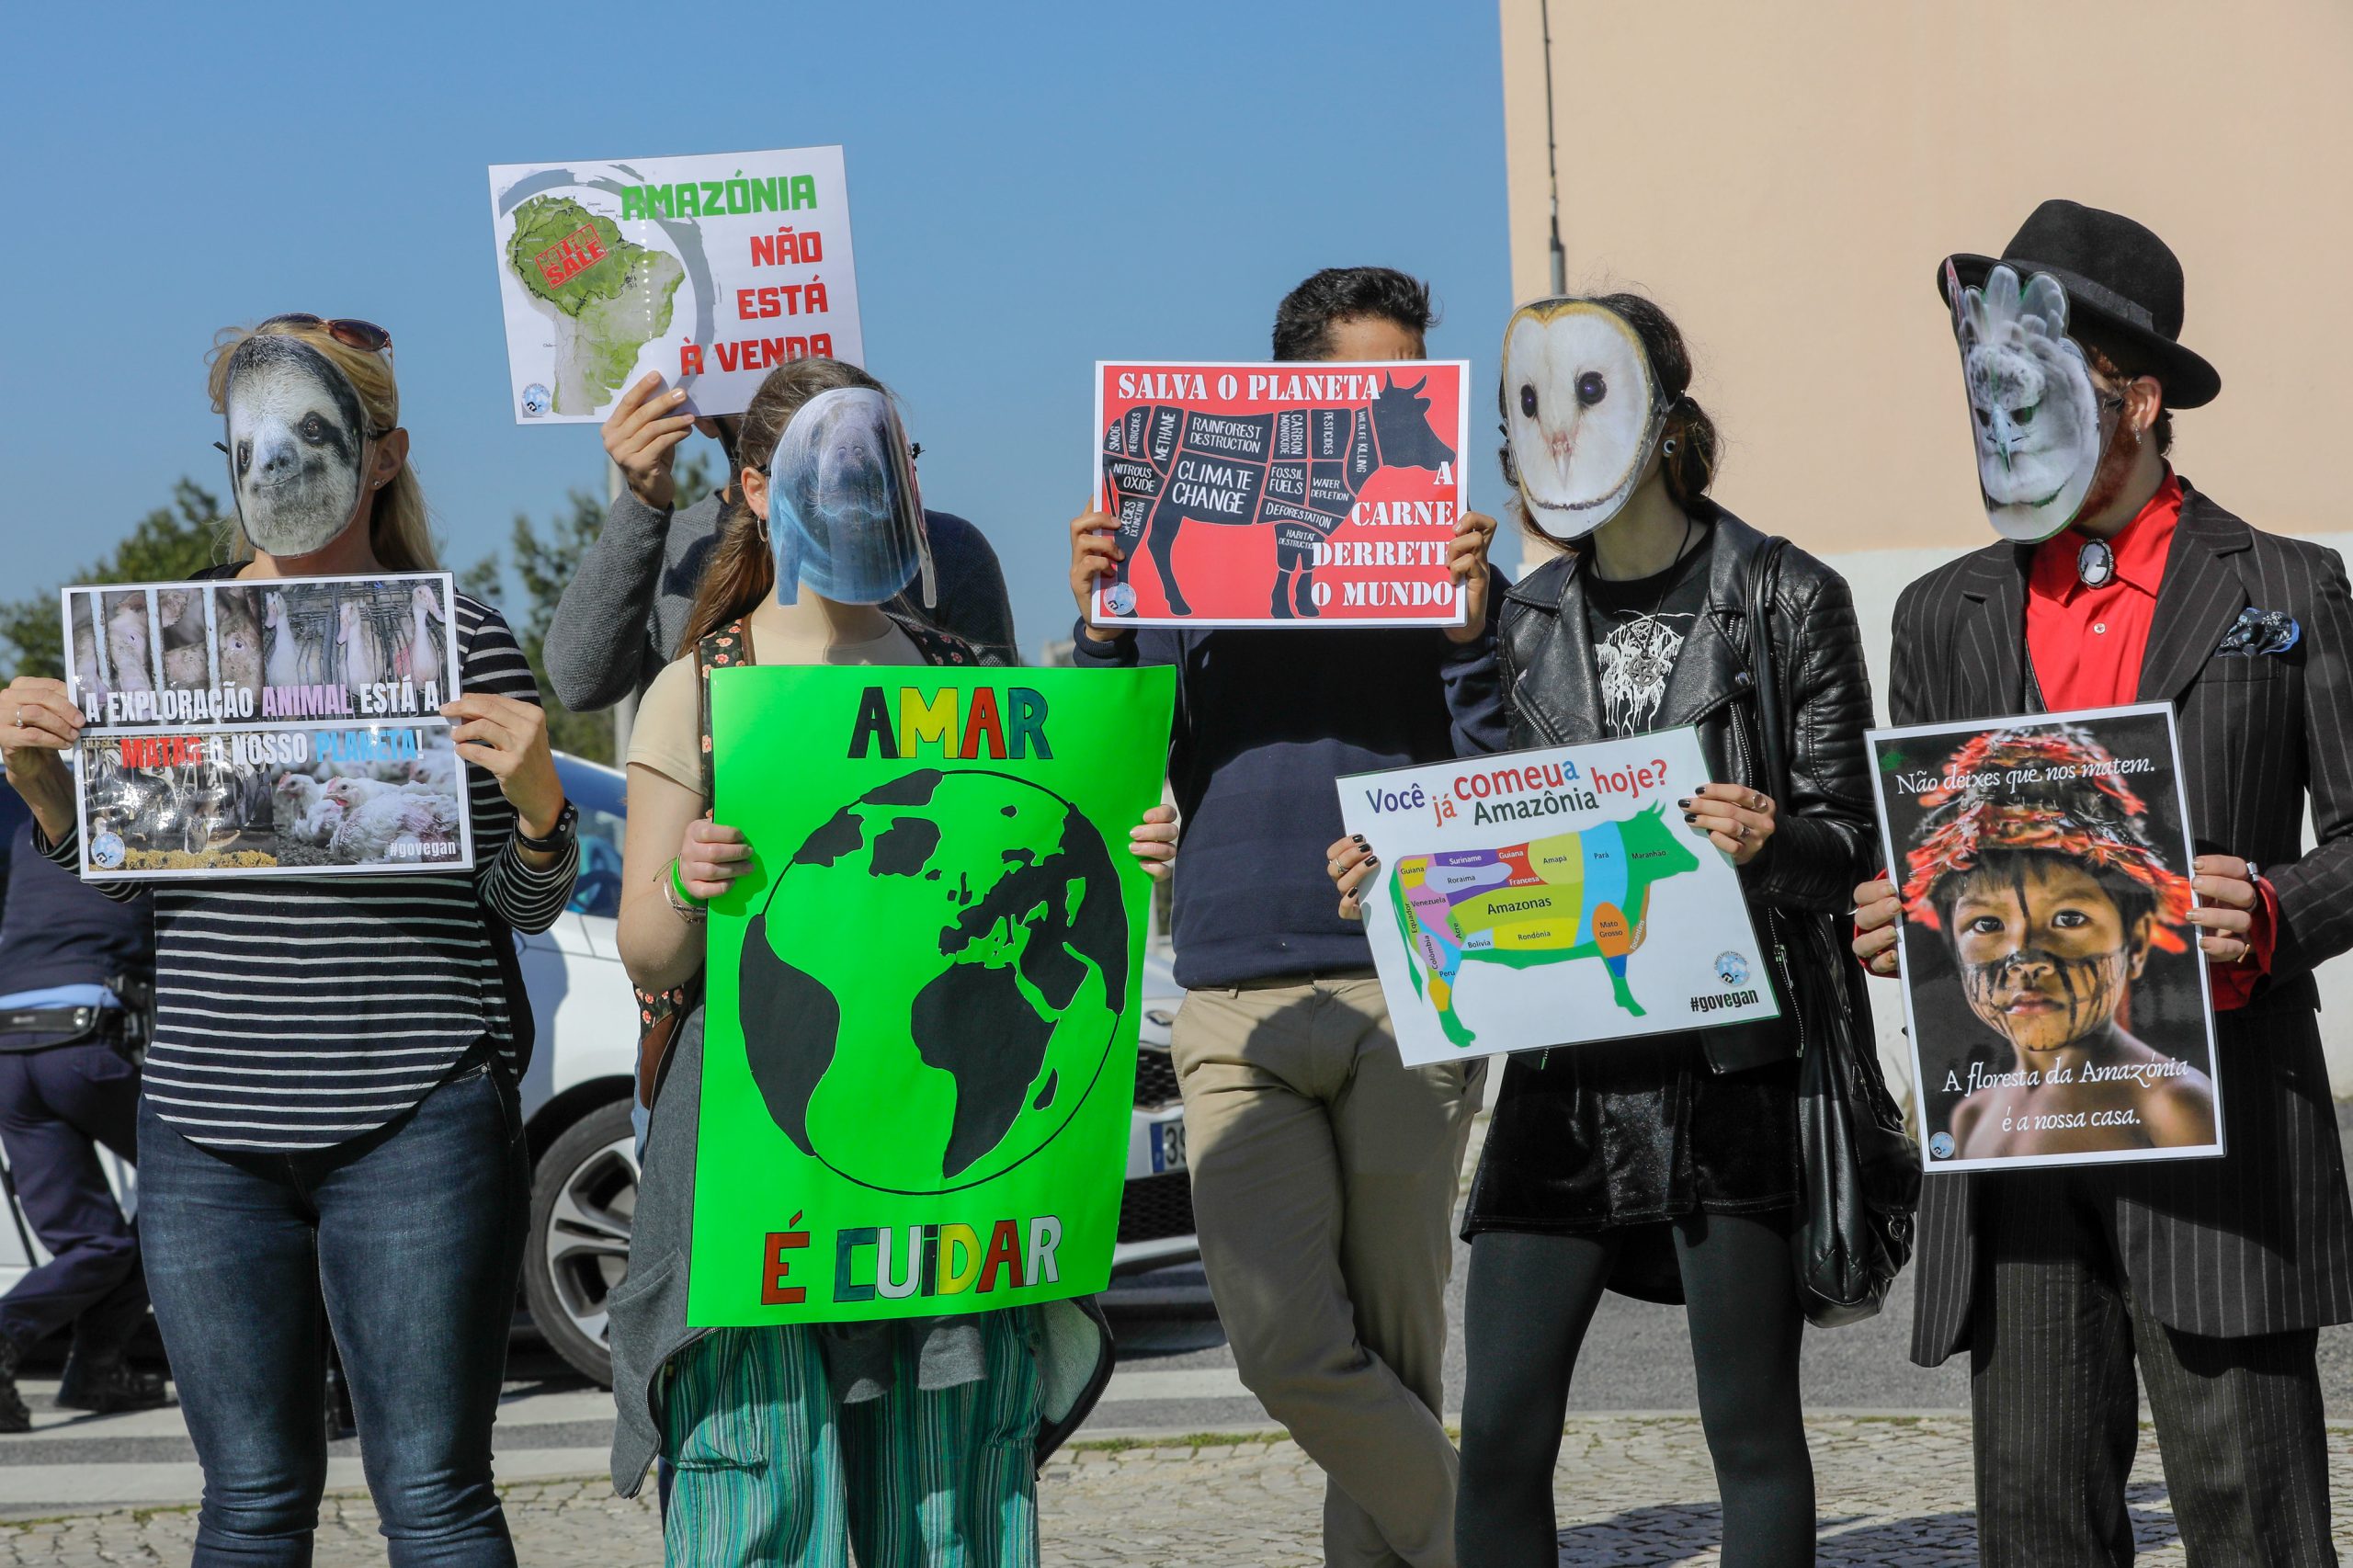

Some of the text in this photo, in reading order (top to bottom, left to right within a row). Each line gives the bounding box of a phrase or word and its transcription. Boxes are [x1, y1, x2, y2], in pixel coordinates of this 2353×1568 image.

[621, 169, 817, 221] AMAZÓNIA
[538, 227, 597, 269] NOT FOR
[750, 226, 823, 267] NÃO
[546, 240, 604, 284] SALE
[737, 274, 828, 320] ESTÁ
[680, 333, 833, 377] À VENDA
[1118, 372, 1381, 401] SALVA O PLANETA
[1109, 426, 1121, 451] SMOG
[1129, 412, 1142, 452] HERBICIDES
[1154, 412, 1176, 460] METHANE
[1192, 417, 1263, 439] RAINFOREST
[1279, 415, 1290, 454] MONOXIDE
[1290, 415, 1303, 454] CARBON
[1324, 412, 1334, 455] PESTICIDES
[1190, 432, 1260, 453] DESTRUCTION
[1113, 463, 1152, 478] NITROUS
[1357, 443, 1368, 473] KILLING
[1123, 476, 1155, 493] OXIDE
[1177, 460, 1254, 490] CLIMATE
[1271, 466, 1303, 480] FOSSIL
[1313, 477, 1340, 489] WATER
[1434, 460, 1454, 485] A
[1172, 483, 1246, 514] CHANGE
[1269, 479, 1303, 494] FUELS
[1311, 490, 1349, 501] DEPLETION
[1130, 502, 1145, 537] EXTINCTION
[1266, 503, 1333, 529] DEFORESTATION
[1351, 501, 1454, 527] CARNE
[1286, 529, 1315, 541] HABITAT
[1313, 541, 1449, 567] DERRETE
[1312, 581, 1453, 607] O MUNDO
[85, 674, 439, 723] A EXPLORAÇÃO ANIMAL ESTÁ A
[847, 686, 1053, 760] AMAR
[209, 735, 224, 764] O
[232, 733, 307, 766] NOSSO
[315, 729, 424, 762] PLANETA!
[1895, 757, 2155, 794] Não deixes que nos matem.
[1366, 783, 1425, 813] Você
[1432, 793, 1457, 827] já
[1591, 758, 1667, 799] hoje?
[1473, 787, 1599, 825] Amazônia
[390, 840, 456, 858] #govegan
[1449, 855, 1482, 865] Suriname
[1499, 850, 1523, 859] Guiana
[1401, 867, 1425, 875] Guiana
[1448, 875, 1475, 884] Roraima
[1509, 876, 1540, 886] Francesa
[1411, 897, 1446, 907] Venezuela
[1487, 897, 1552, 915] Amazonas
[1405, 903, 1417, 933] Equador
[1453, 923, 1461, 938] Acre
[1599, 920, 1618, 928] Mato
[1599, 929, 1622, 937] Grosso
[1630, 920, 1645, 951] Tocantins
[1690, 989, 1759, 1013] #govegan
[1942, 1051, 2188, 1097] A floresta da Amazónia
[2002, 1107, 2141, 1131] é a nossa casa.
[760, 1210, 810, 1305] É
